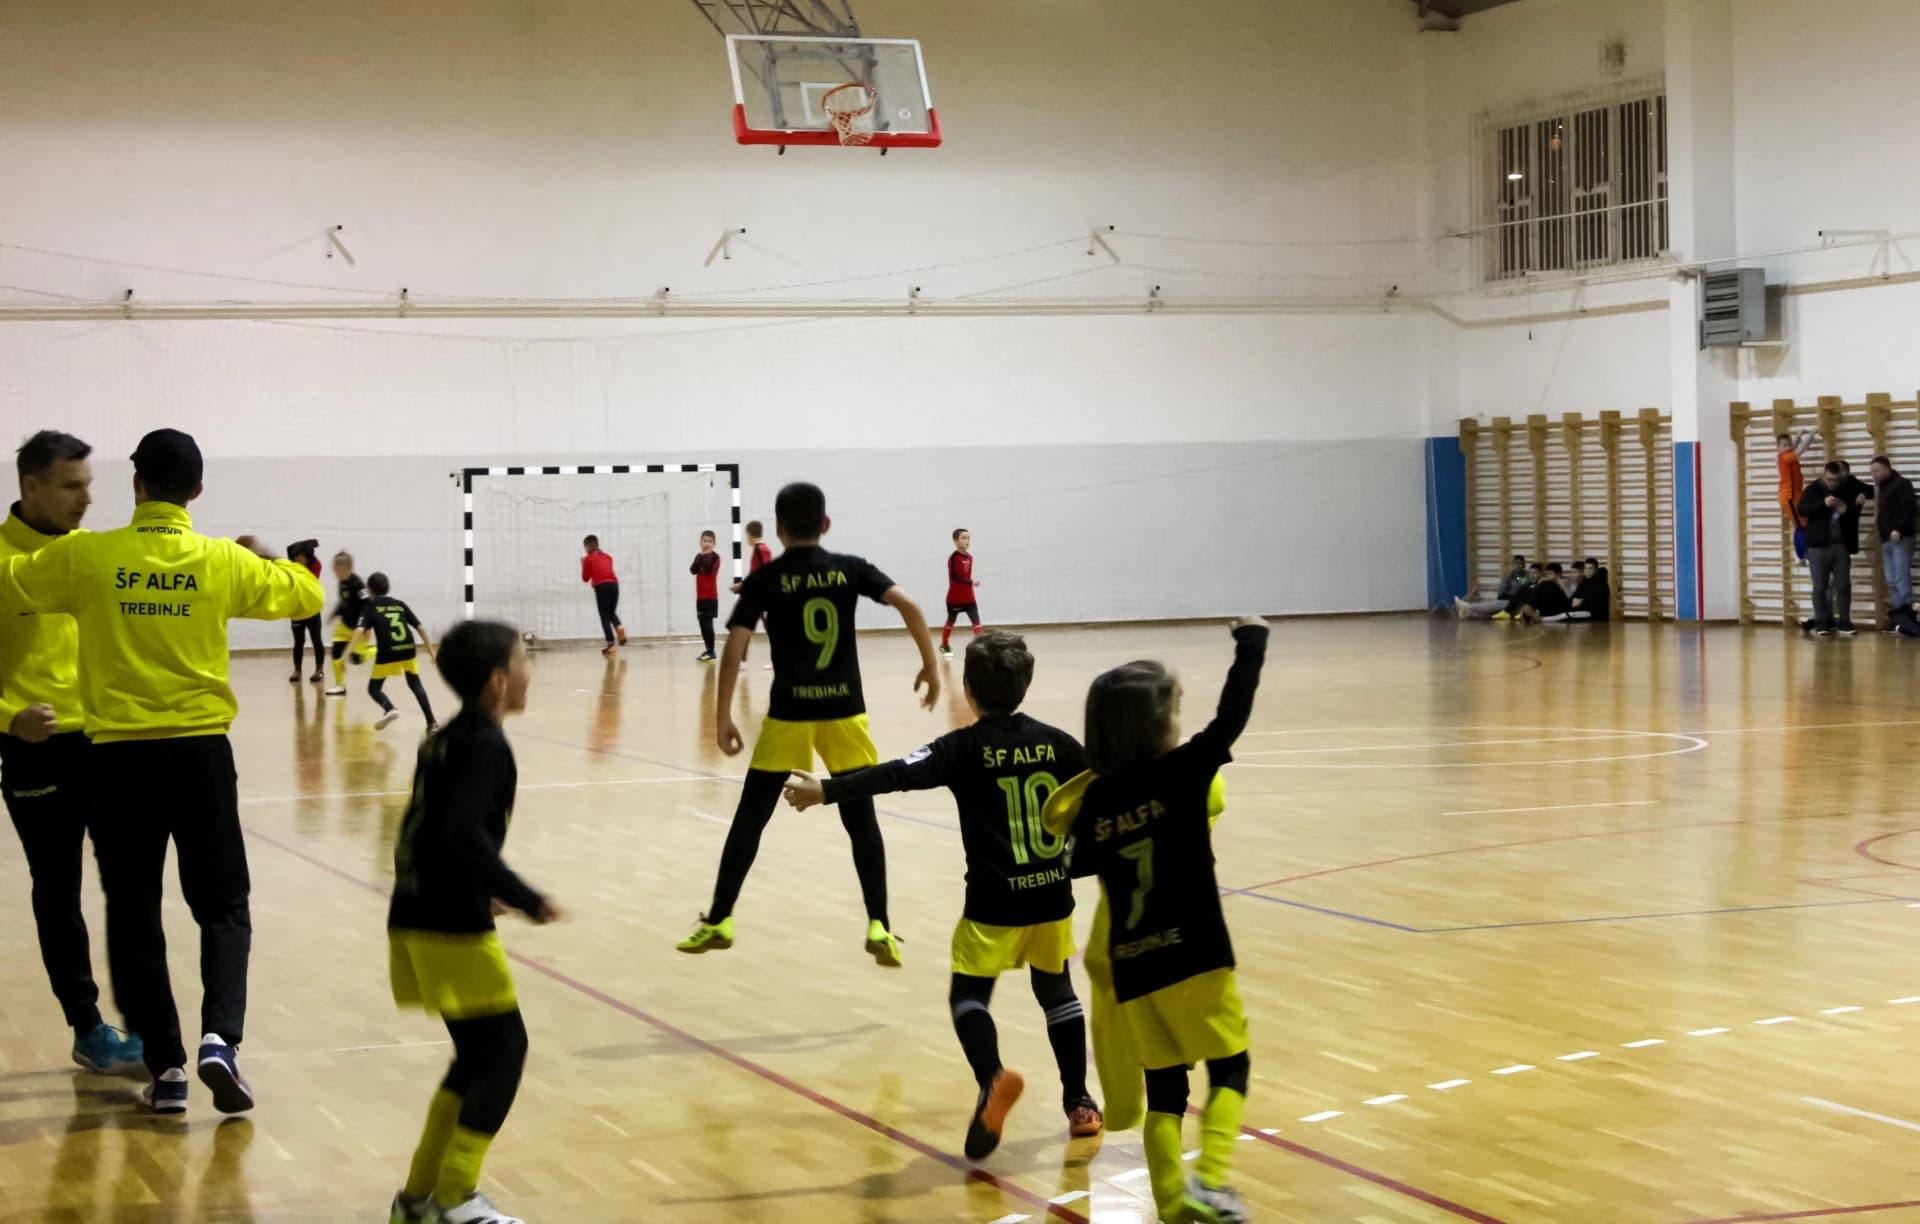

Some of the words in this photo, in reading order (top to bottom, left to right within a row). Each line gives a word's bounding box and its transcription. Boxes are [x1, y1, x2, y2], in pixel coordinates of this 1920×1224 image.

[136, 526, 183, 535] GIVOVA
[115, 567, 142, 589] ŠF
[146, 572, 199, 591] ALFA
[807, 570, 848, 589] ALFA
[120, 602, 191, 617] TREBINJE
[384, 612, 407, 642] 3
[803, 597, 839, 669] 9
[983, 745, 1008, 769] ŠF
[1013, 744, 1056, 765] ALFA
[997, 771, 1066, 865] 10
[1116, 799, 1166, 835] ALFA
[1008, 866, 1068, 892] TREBINJ
[1118, 837, 1154, 929] 7
